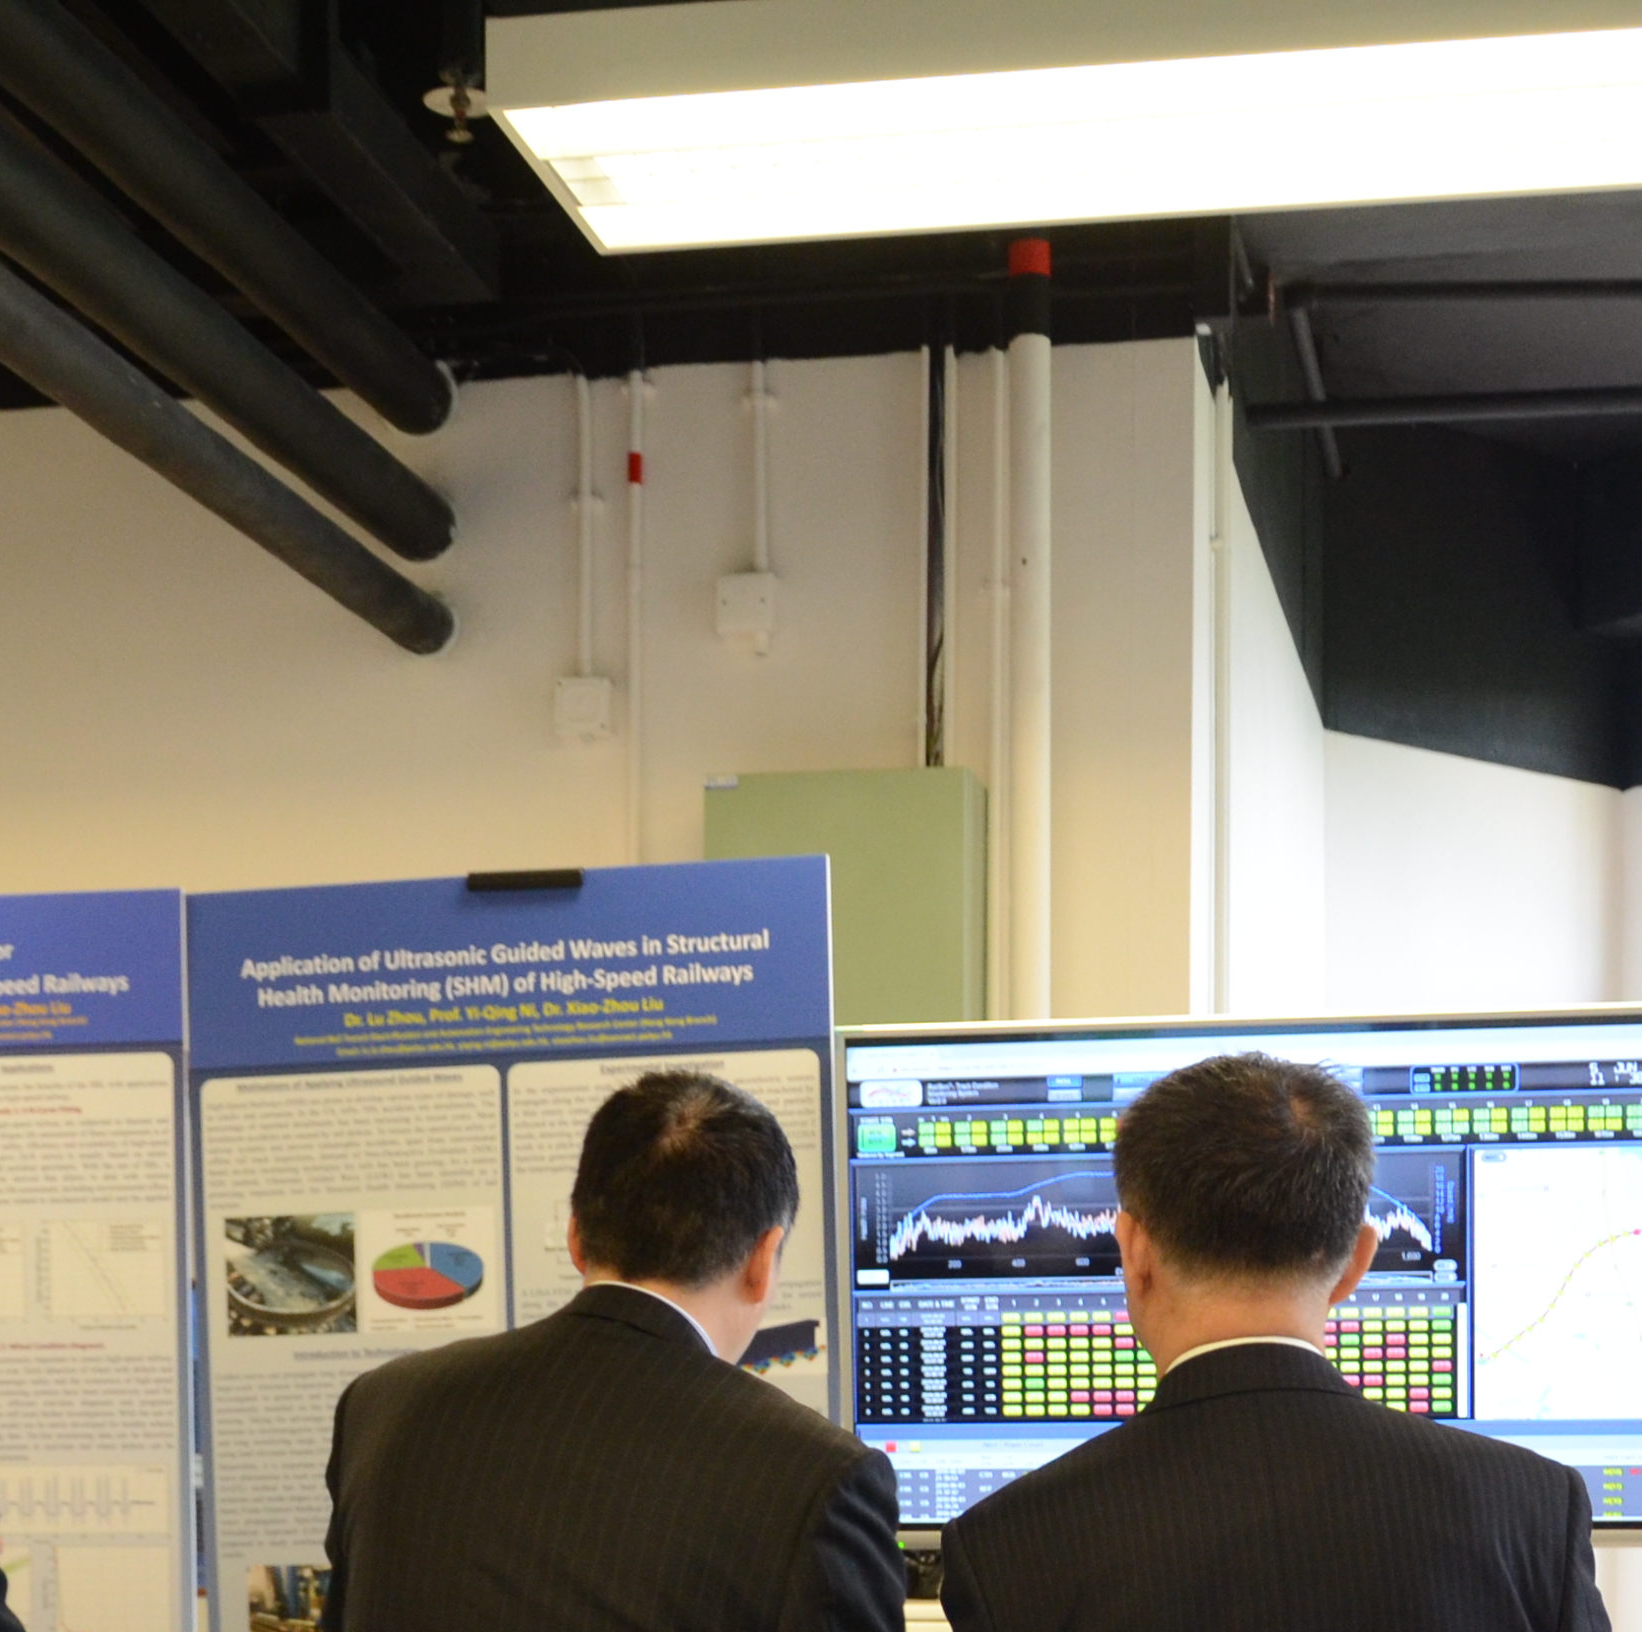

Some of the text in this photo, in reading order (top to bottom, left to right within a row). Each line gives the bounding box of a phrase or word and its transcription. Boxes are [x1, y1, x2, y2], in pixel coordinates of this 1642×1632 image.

[240, 928, 770, 981] Application of Ultrasonic Guided Waves in Structural
[43, 972, 130, 996] Railways
[257, 962, 754, 1008] Health Monitoring (SHM) of High-Speed Railways
